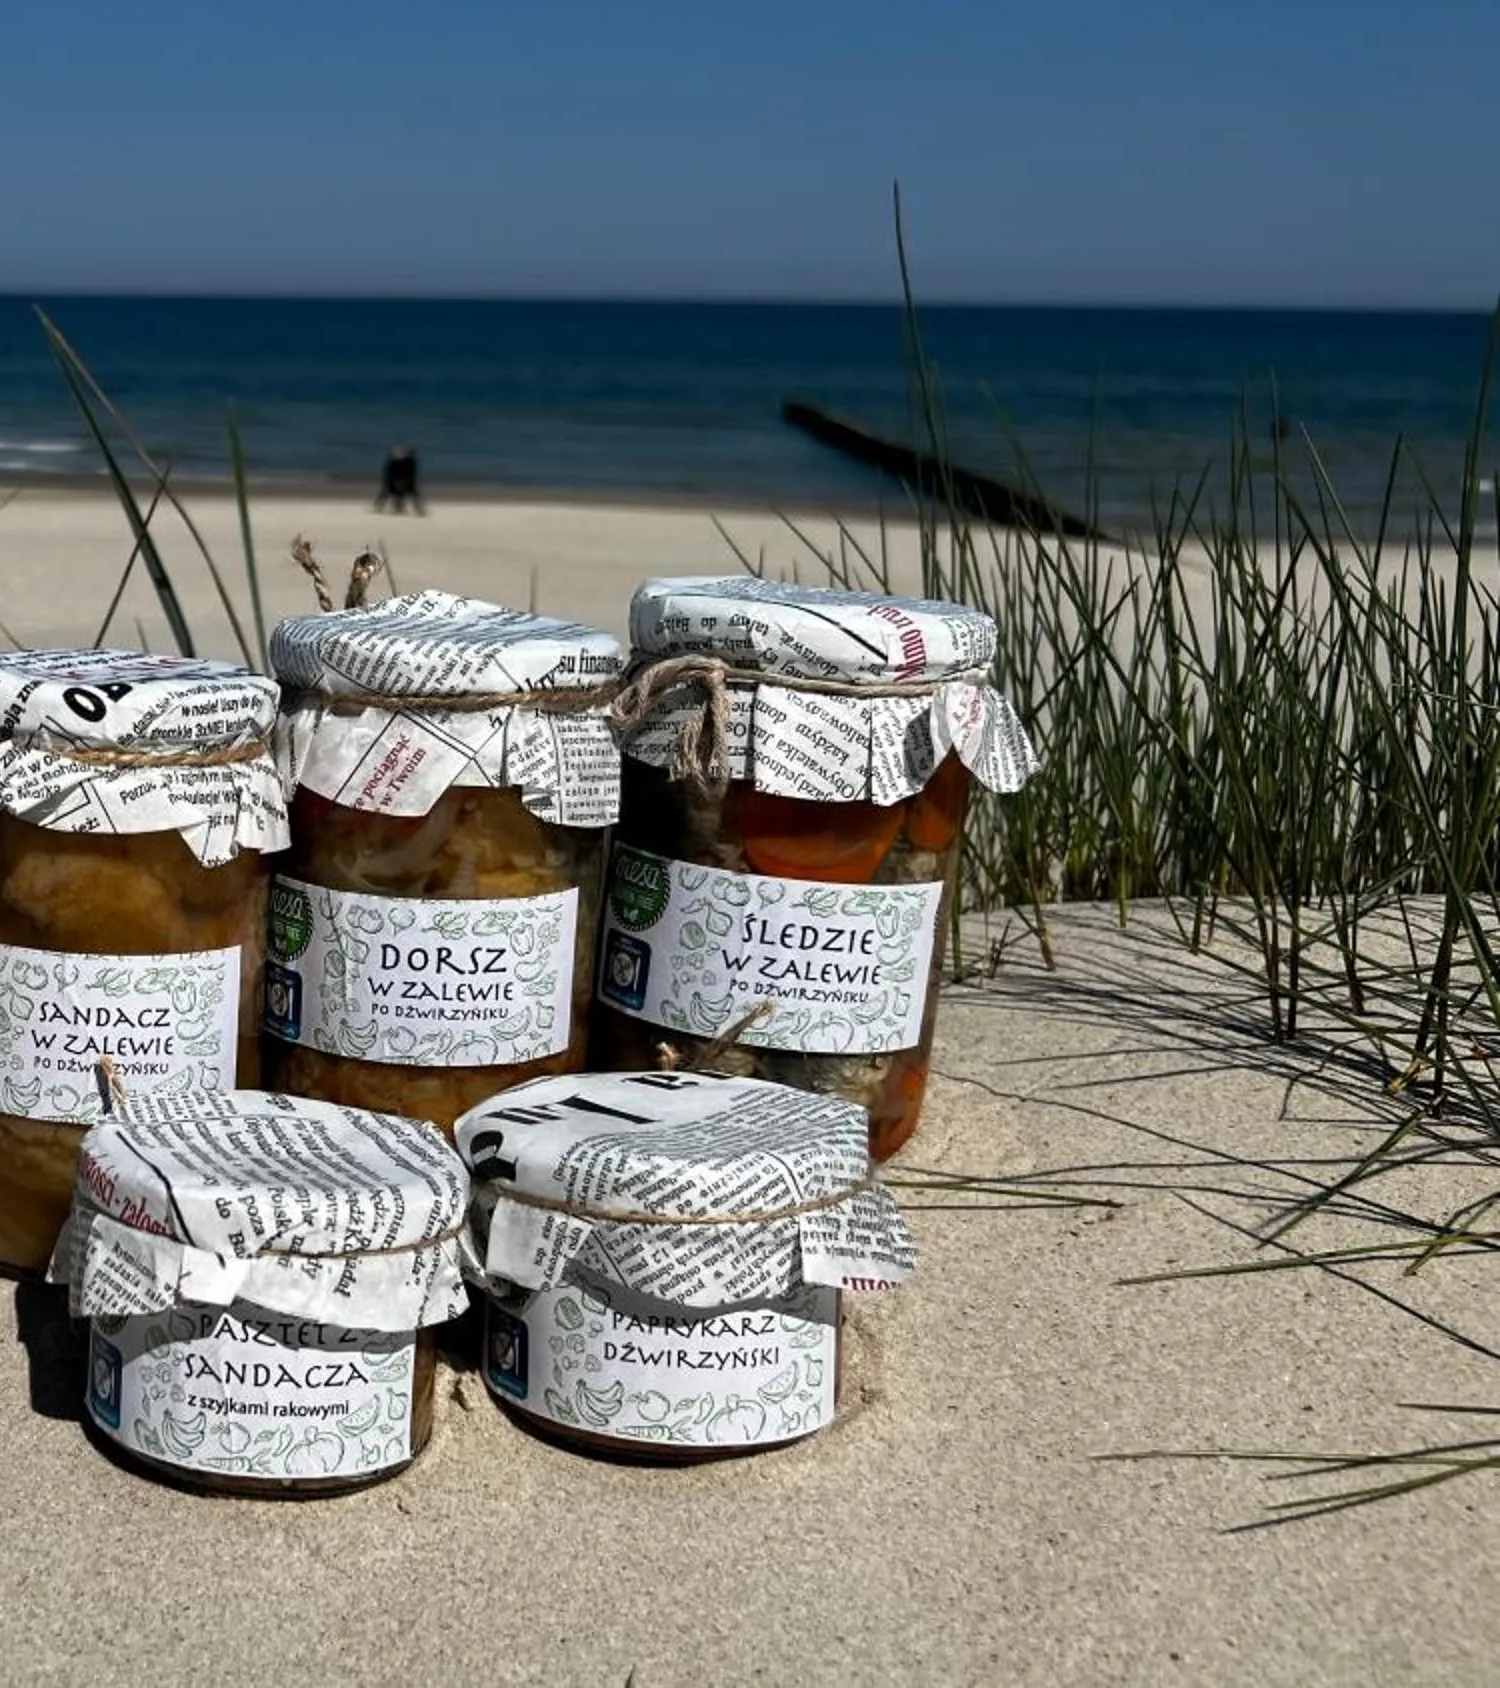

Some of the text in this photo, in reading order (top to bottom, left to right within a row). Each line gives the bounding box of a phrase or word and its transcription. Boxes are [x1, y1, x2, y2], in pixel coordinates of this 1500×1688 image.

[387, 746, 427, 793] Twoim
[776, 738, 855, 798] Obywatelka
[741, 913, 875, 955] ŚLEDZIE
[381, 943, 508, 974] DORSZ
[722, 949, 882, 986] W ZALEWIE
[367, 977, 515, 1002] W ZALEWIE
[729, 978, 870, 1005] PO DŹWIRZYŃSKU
[39, 1001, 172, 1028] SANDACZ
[371, 1003, 509, 1021] PO DŹWIRZYŃSKU
[31, 1029, 175, 1056] W ZALEWIE
[34, 1055, 51, 1070] PO
[201, 1313, 326, 1347] PASZTET
[611, 1311, 776, 1338] PAPRYKARZ
[603, 1342, 780, 1371] DŹWIRZYŃSKI
[184, 1353, 370, 1389] SANDACZA
[188, 1394, 349, 1420] z szyjkami rakowymi
